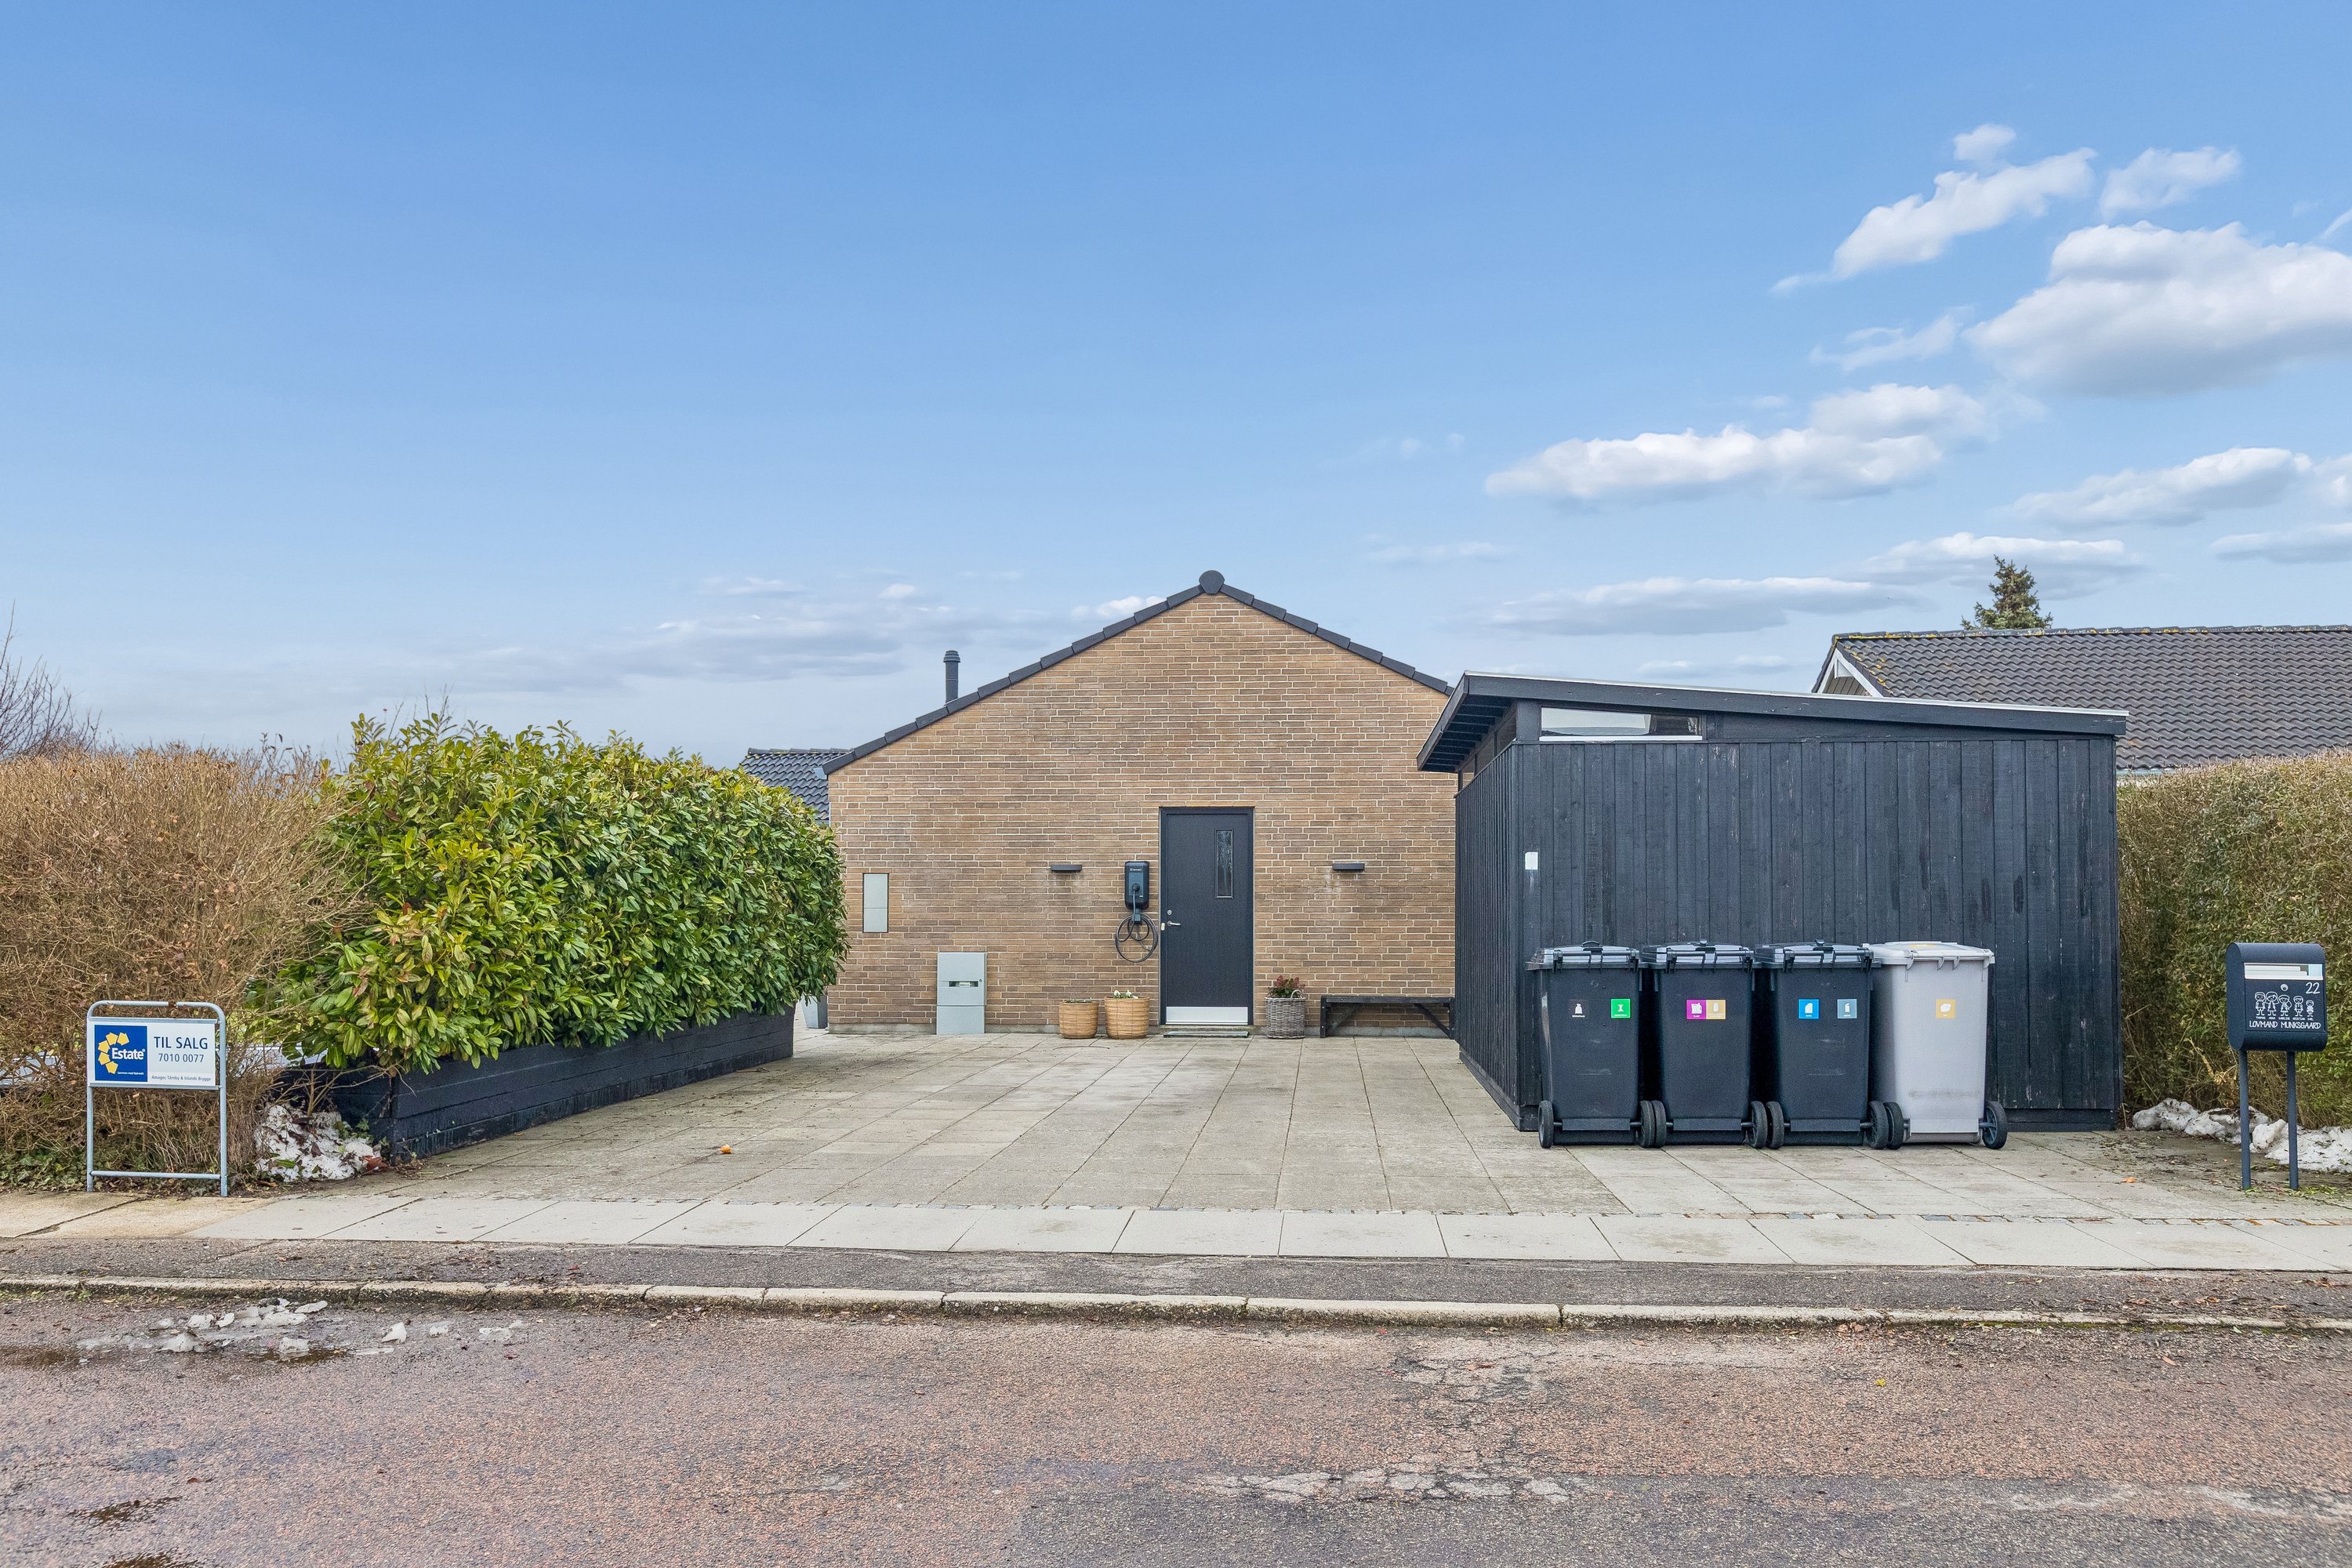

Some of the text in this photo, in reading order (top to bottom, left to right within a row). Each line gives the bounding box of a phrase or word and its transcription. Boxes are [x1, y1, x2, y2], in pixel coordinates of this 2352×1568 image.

[2306, 982, 2321, 994] 22
[2281, 1021, 2321, 1029] MUNKSGAARD
[154, 1036, 208, 1051] TIL SALG
[158, 1054, 205, 1063] 7010 0077
